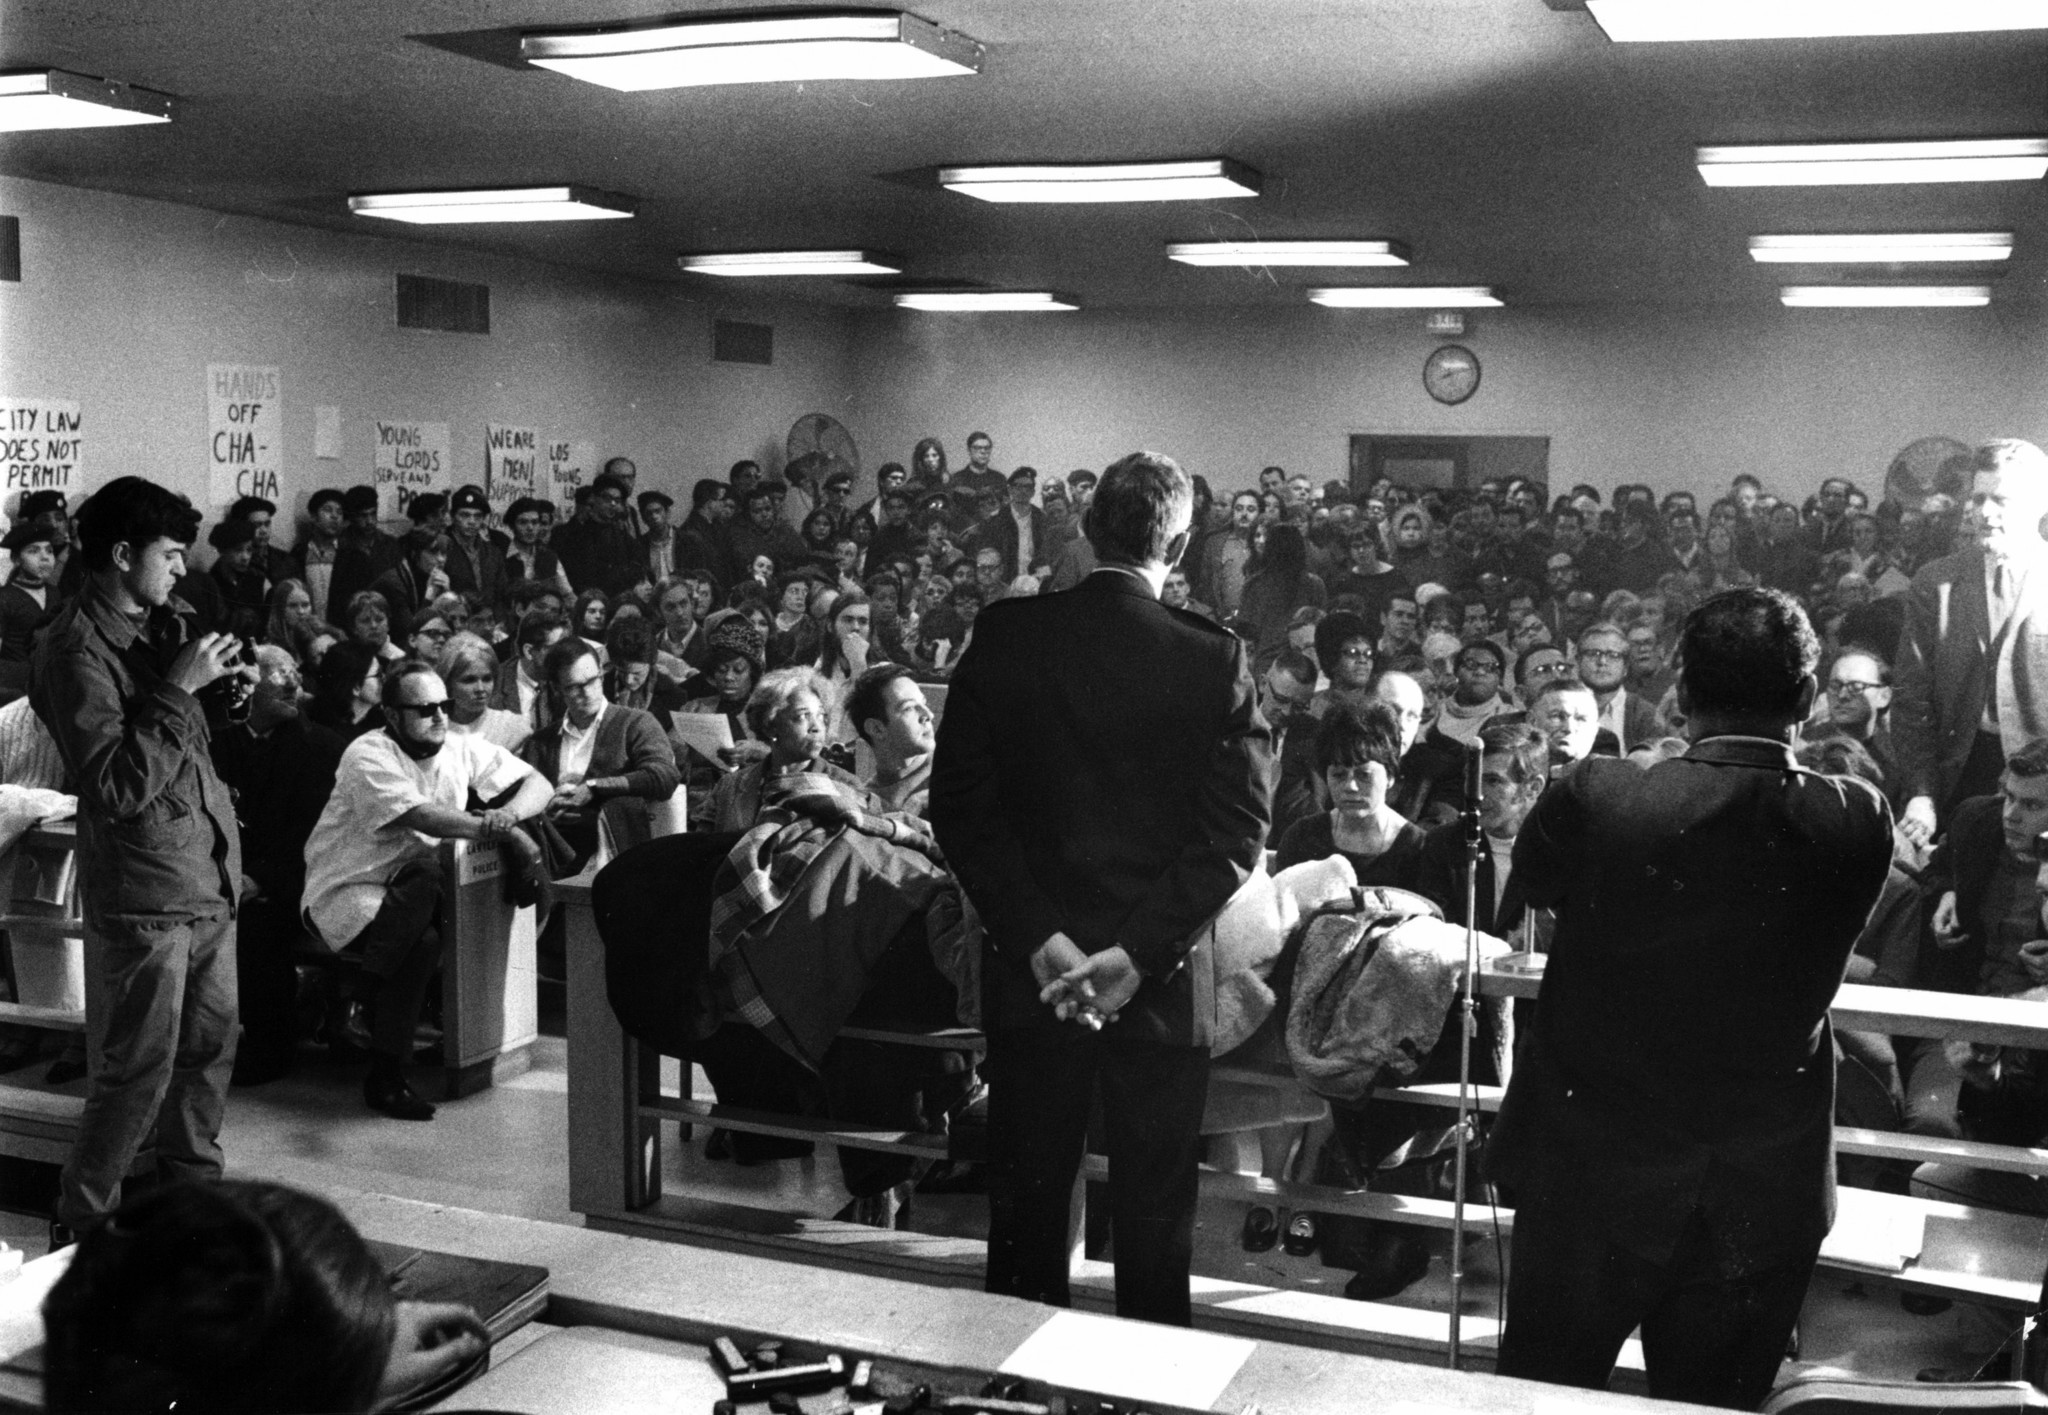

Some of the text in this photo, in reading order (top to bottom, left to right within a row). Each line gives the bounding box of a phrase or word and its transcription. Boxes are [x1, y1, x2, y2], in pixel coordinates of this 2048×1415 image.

[215, 370, 277, 400] HANDS
[46, 410, 81, 432] LAW
[228, 403, 262, 423] OFF
[377, 421, 422, 446] YOUNG
[46, 439, 81, 460] NOT
[395, 447, 440, 471] LORDS
[549, 443, 569, 462] LOS
[7, 464, 73, 488] PERMIT
[502, 455, 535, 487] MEN!
[236, 469, 279, 498] CHA
